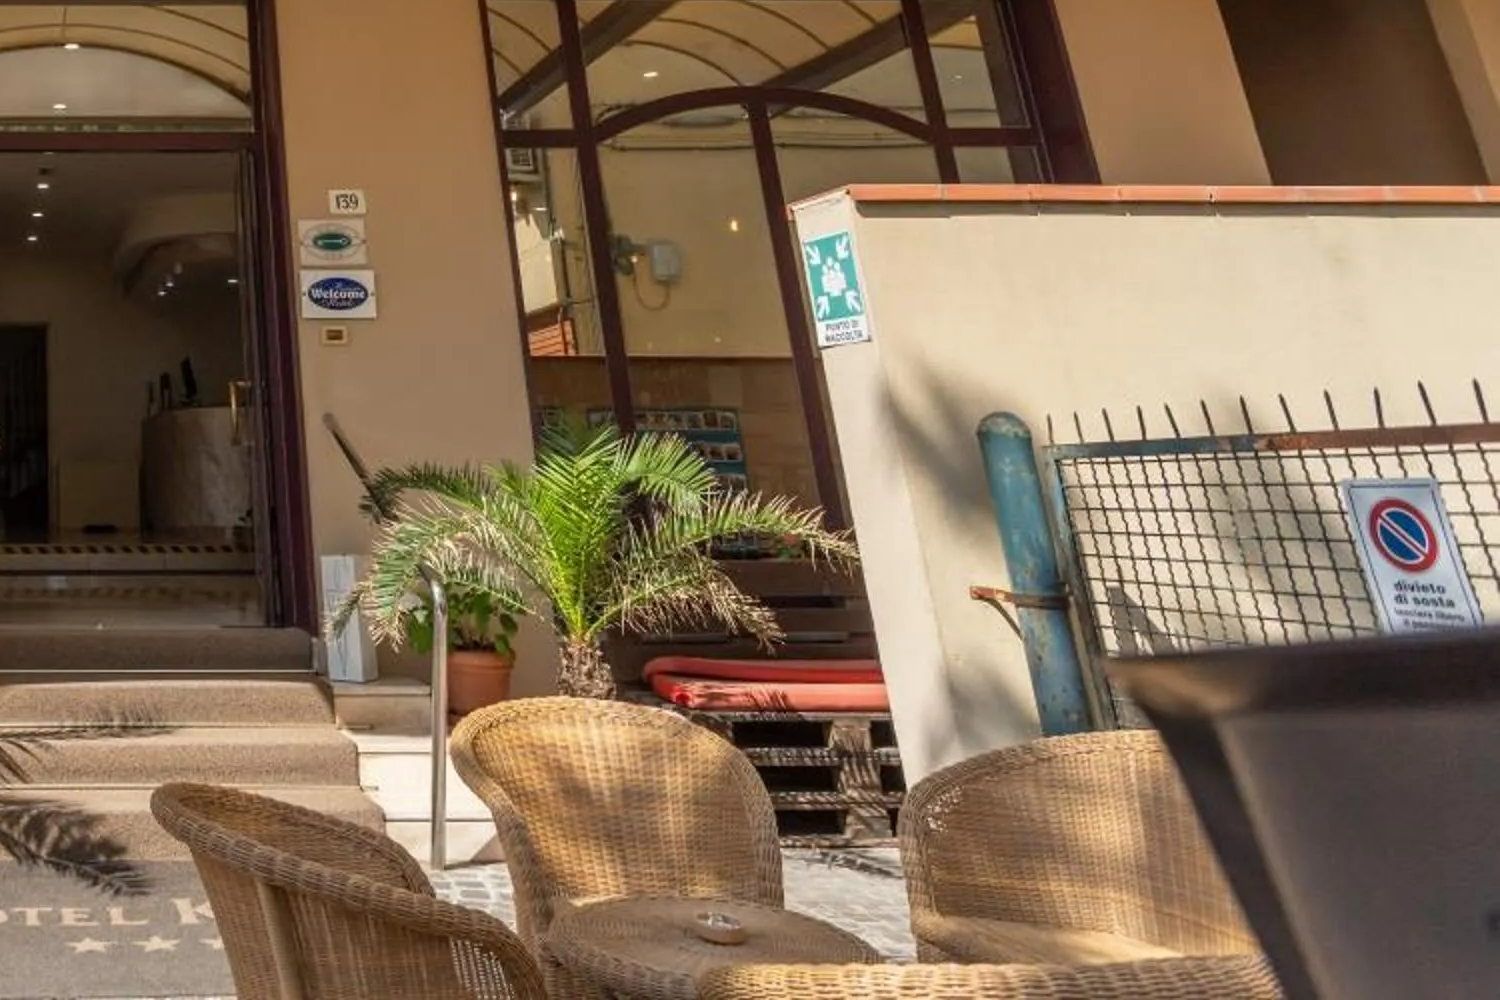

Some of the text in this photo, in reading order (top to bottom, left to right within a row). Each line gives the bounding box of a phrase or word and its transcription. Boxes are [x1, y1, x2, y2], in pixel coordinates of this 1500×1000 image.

[335, 193, 359, 210] 139
[311, 288, 366, 300] Welcome
[1394, 580, 1446, 595] divieto
[1394, 594, 1456, 608] di sosta
